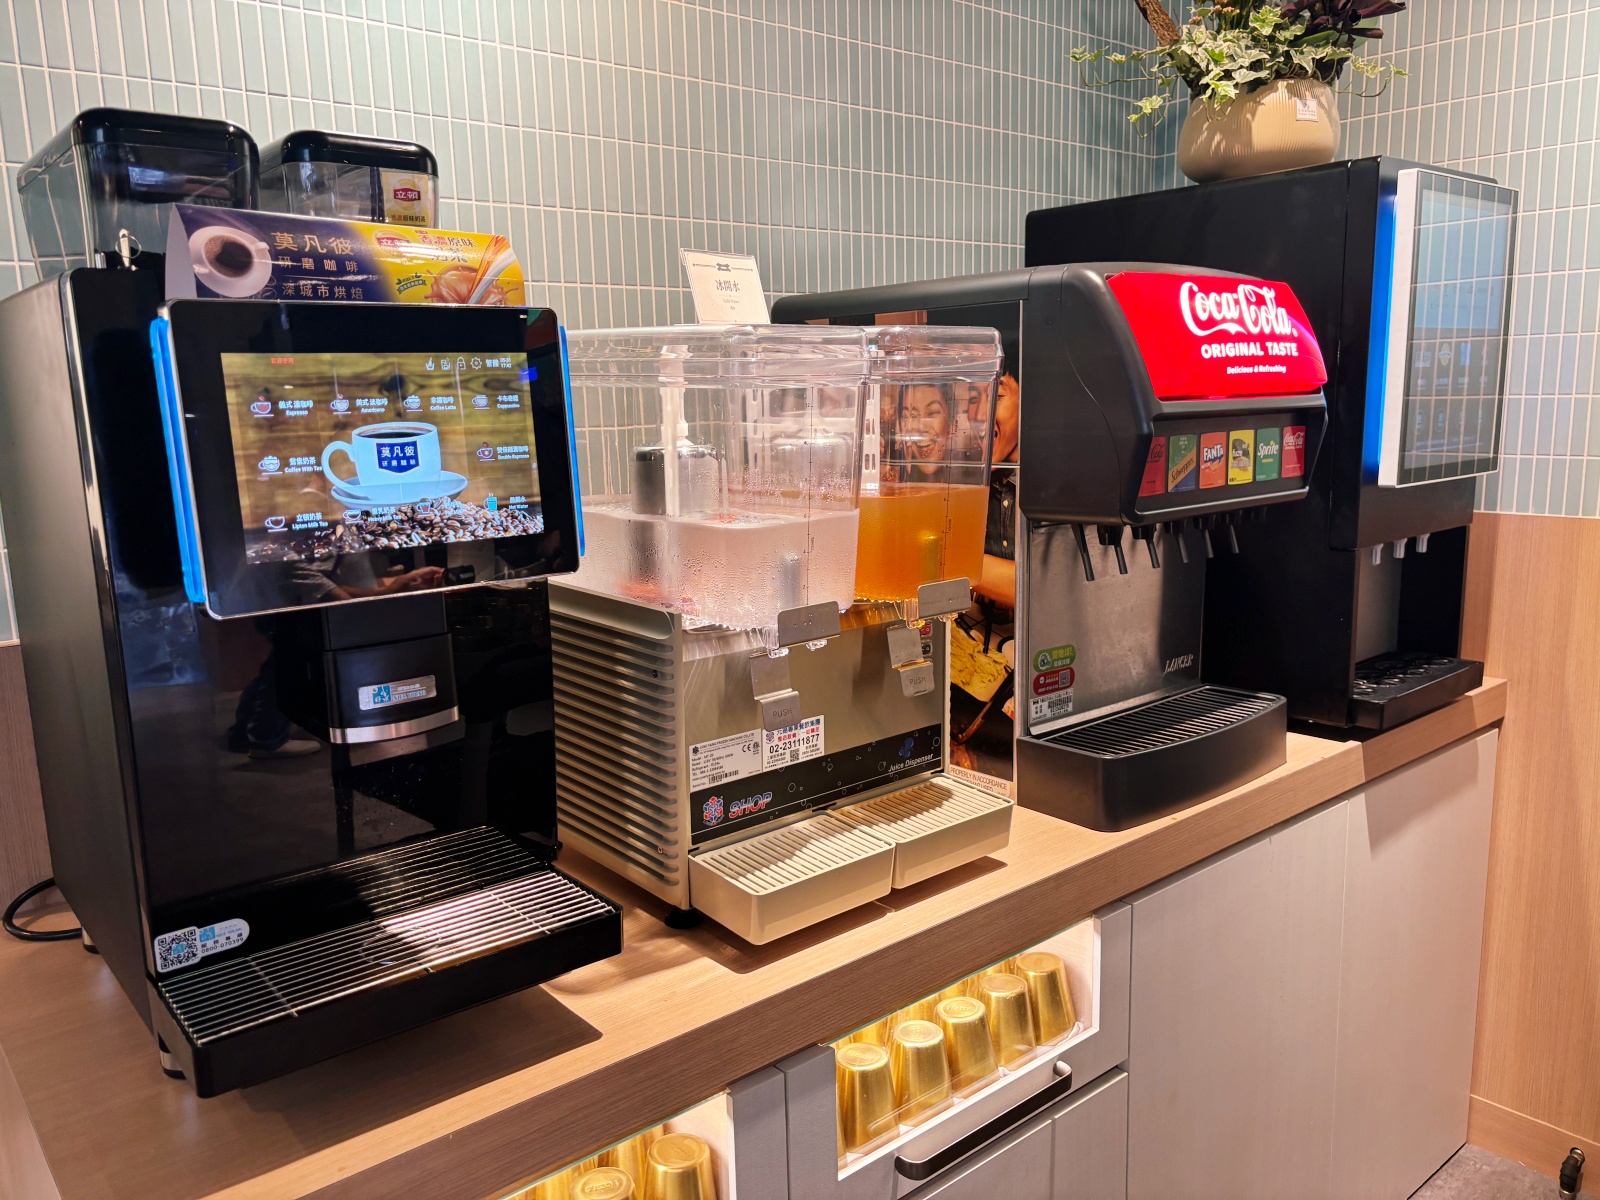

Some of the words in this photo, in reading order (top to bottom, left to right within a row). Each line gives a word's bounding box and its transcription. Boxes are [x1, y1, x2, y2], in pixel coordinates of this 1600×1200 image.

[396, 190, 419, 200] 立頓
[272, 231, 356, 256] 莫凡彼
[419, 235, 477, 248] 香濃原味
[278, 256, 359, 273] 研磨咖啡
[282, 282, 364, 300] 深城市烘焙
[1180, 281, 1293, 337] Coca-Cola
[1201, 342, 1265, 359] ORIGINAL
[1265, 342, 1299, 357] TASTE
[1227, 365, 1254, 375] Delicious
[1254, 364, 1259, 374] &
[1259, 364, 1287, 374] Refreshing
[380, 445, 416, 458] 莫凡彼
[1203, 443, 1225, 462] FANTA
[1257, 442, 1279, 459] Sprite
[909, 675, 927, 686] PUSH
[772, 708, 793, 718] PUSH
[769, 733, 820, 754] 02-23111877
[888, 762, 905, 773] Juice
[904, 752, 934, 768] Dispenser
[950, 766, 972, 780] PROPERLY
[977, 774, 1008, 791] ACCORDANCE
[728, 791, 773, 819] SHOP
[201, 936, 244, 954] 0800-070399
